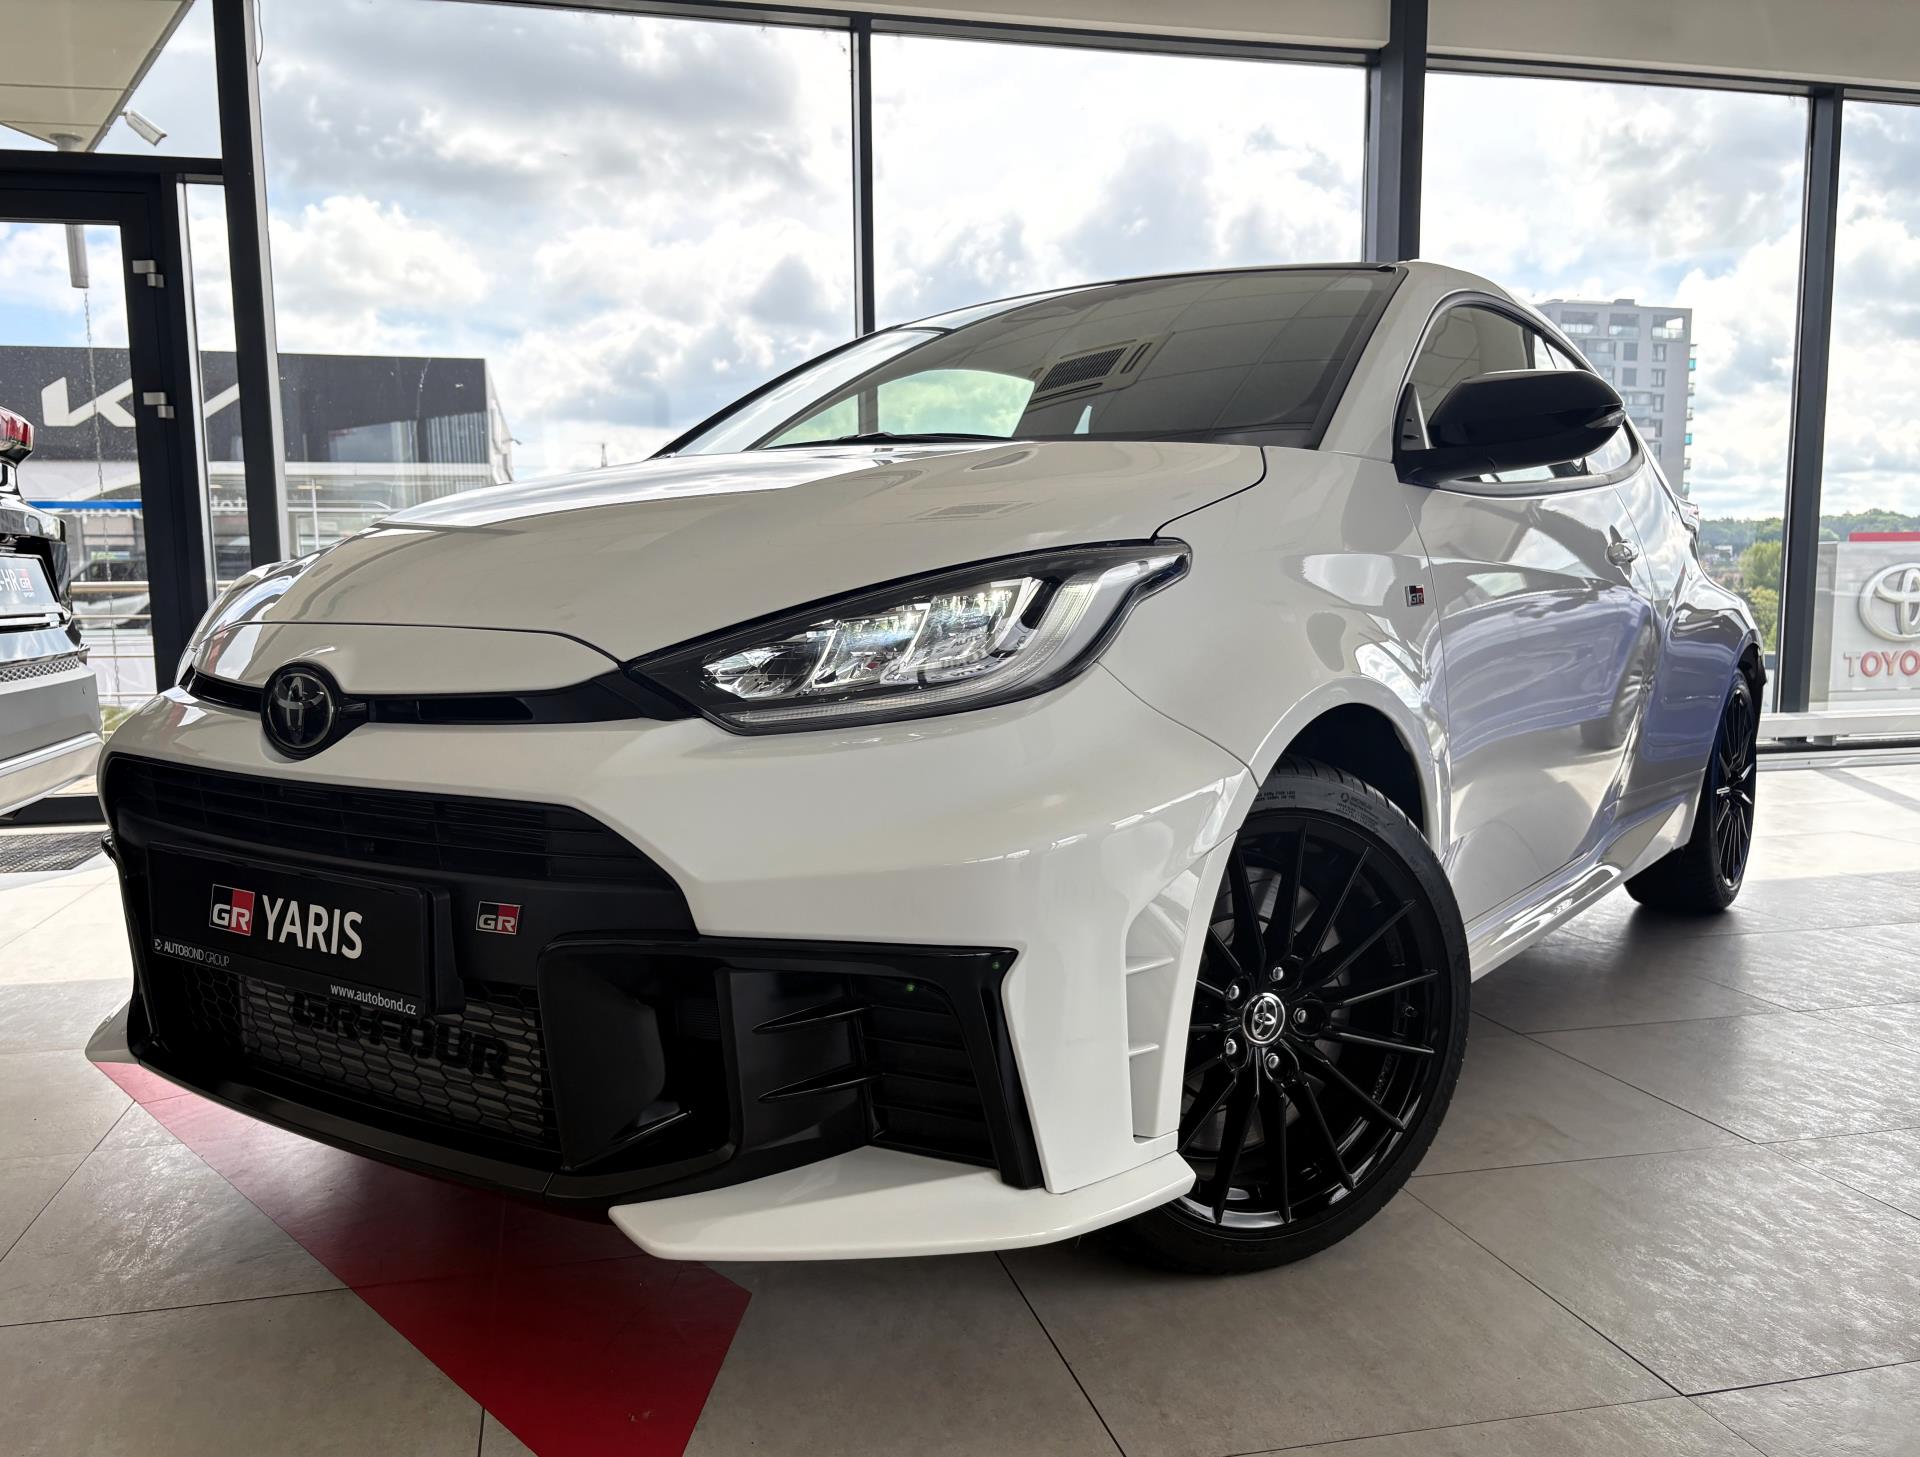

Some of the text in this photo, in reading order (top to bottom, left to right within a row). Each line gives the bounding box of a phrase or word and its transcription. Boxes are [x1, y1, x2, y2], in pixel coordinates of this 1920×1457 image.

[0, 568, 21, 592] -HR
[1410, 593, 1424, 604] GR
[1843, 650, 1920, 678] TOYO
[212, 894, 363, 960] GR YARIS
[479, 914, 516, 932] GR
[163, 940, 230, 967] AUTOBOND GROUP
[330, 983, 416, 1016] www.autobond.cz
